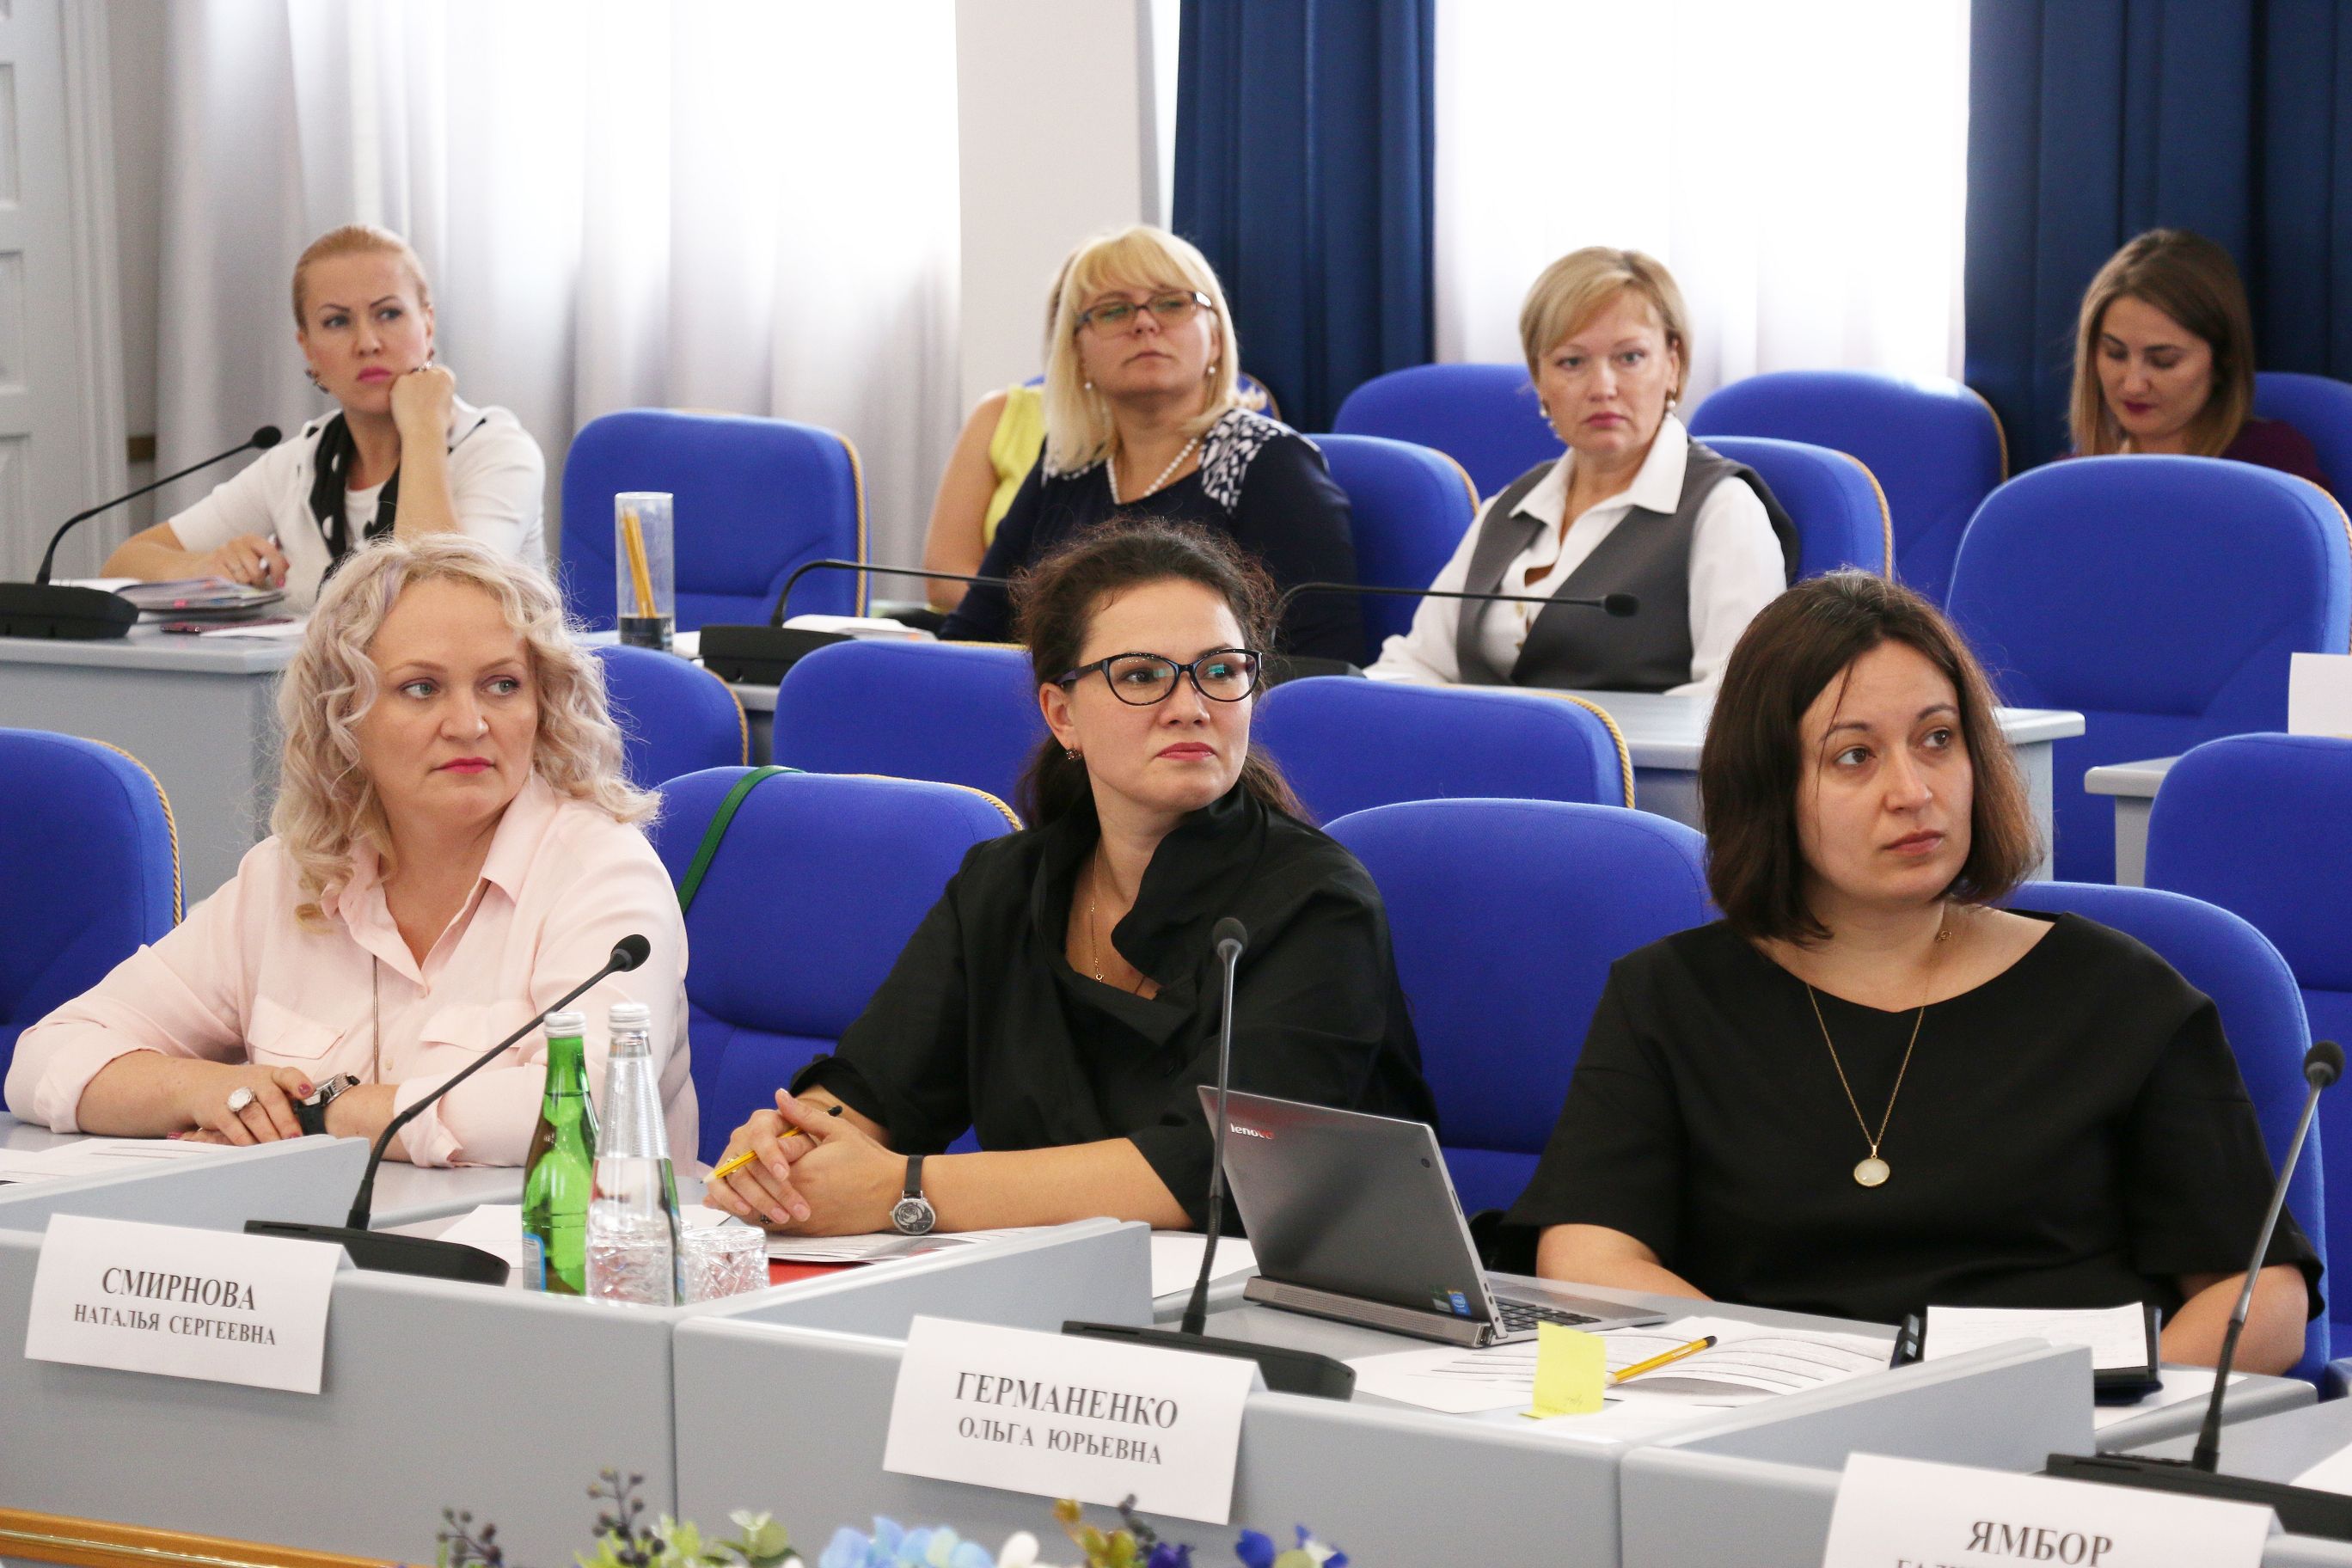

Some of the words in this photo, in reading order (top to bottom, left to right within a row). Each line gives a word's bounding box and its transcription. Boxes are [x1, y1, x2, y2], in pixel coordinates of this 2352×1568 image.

[101, 1267, 256, 1310] СМИРНОВА
[74, 1304, 161, 1332] НАТАЛЬЯ
[169, 1315, 276, 1345] СЕРГЕЕВНА
[954, 1372, 1179, 1429] ГЕРМАНЕНКО
[959, 1417, 1035, 1447] ОЛЬГА
[1046, 1429, 1162, 1464] ЮРЬЕВНА
[1965, 1520, 2113, 1567] ЯМБОР
